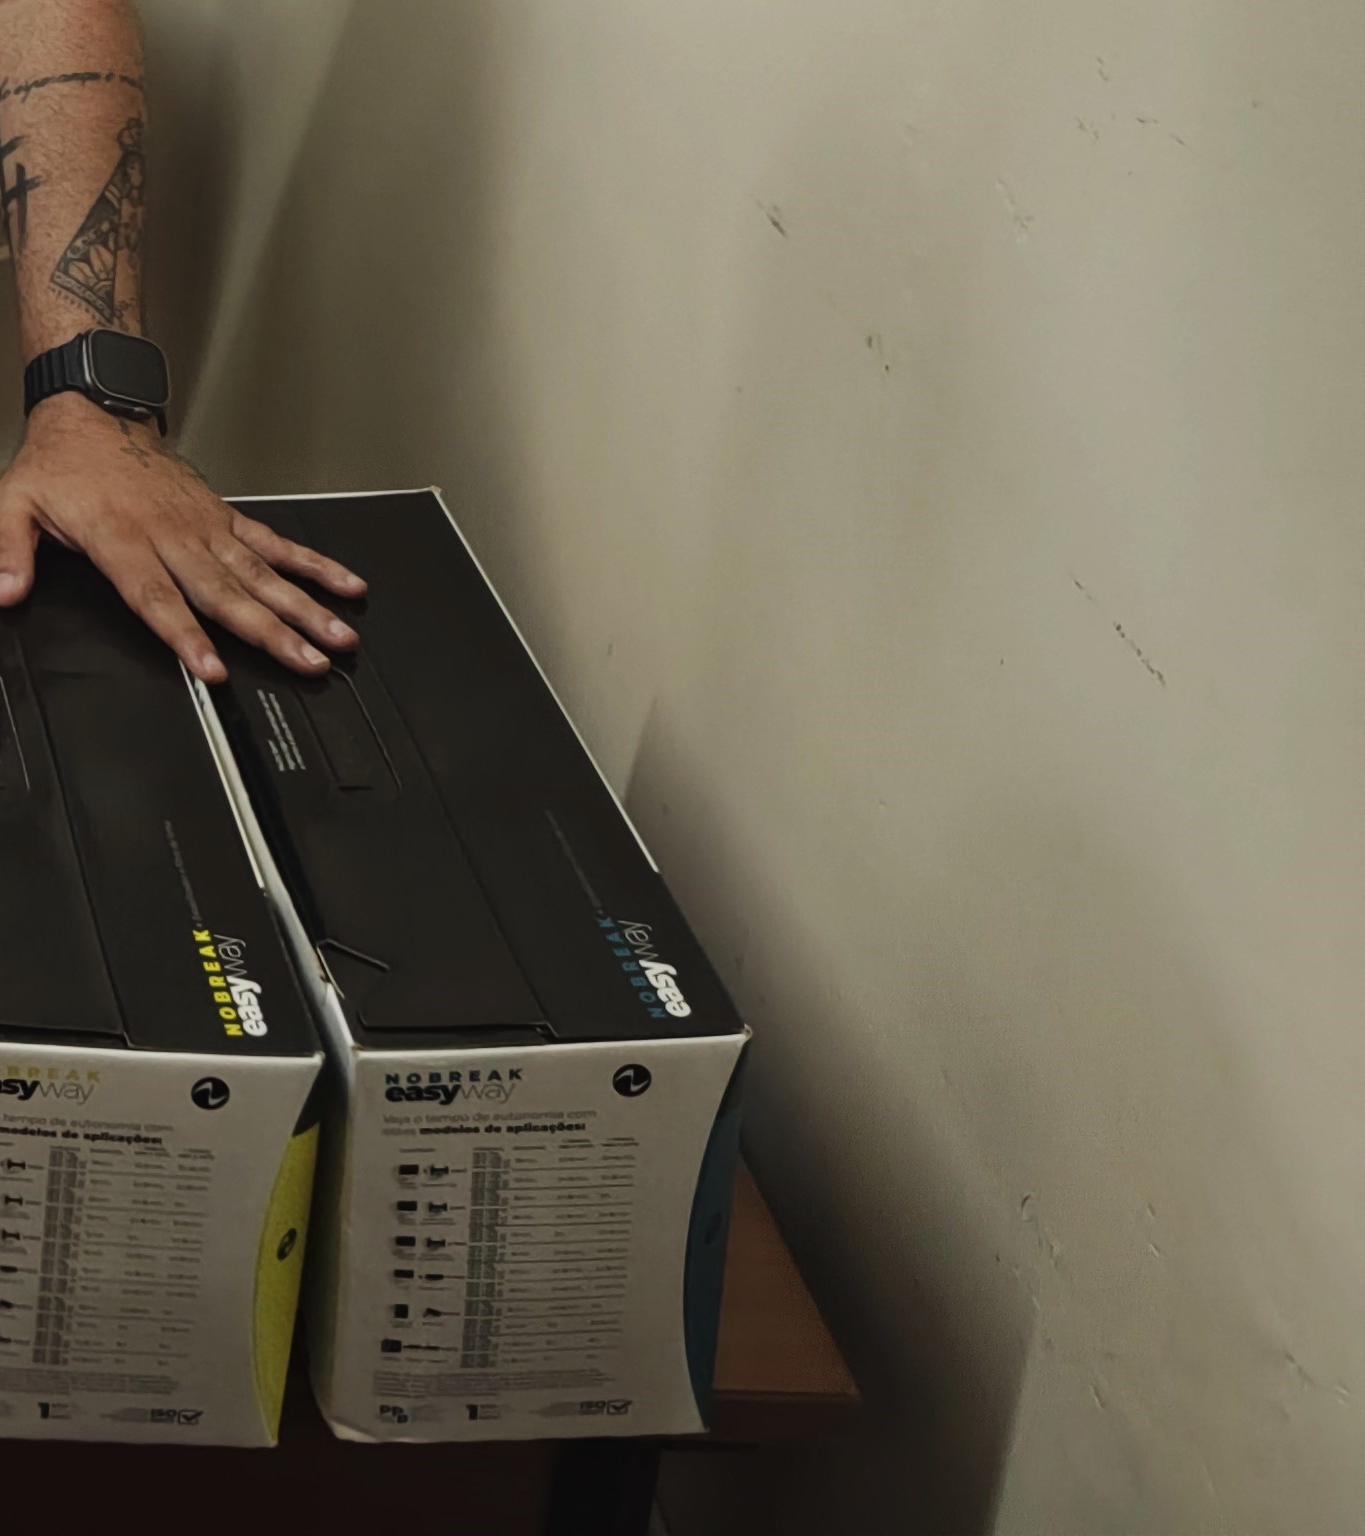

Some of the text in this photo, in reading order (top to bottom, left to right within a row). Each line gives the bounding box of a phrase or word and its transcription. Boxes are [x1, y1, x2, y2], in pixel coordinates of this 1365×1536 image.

[192, 929, 243, 1036] NOBREAK
[213, 934, 268, 1037] easyway
[596, 916, 667, 1019] NOBREAK
[617, 919, 692, 1018] easyway
[384, 1068, 524, 1085] NOBREAK
[385, 1083, 516, 1105] easyway
[61, 1129, 79, 1139] de
[83, 1131, 162, 1145] aplicações:
[419, 1124, 480, 1135] modelos
[484, 1123, 501, 1133] de
[506, 1122, 586, 1134] aplicações:
